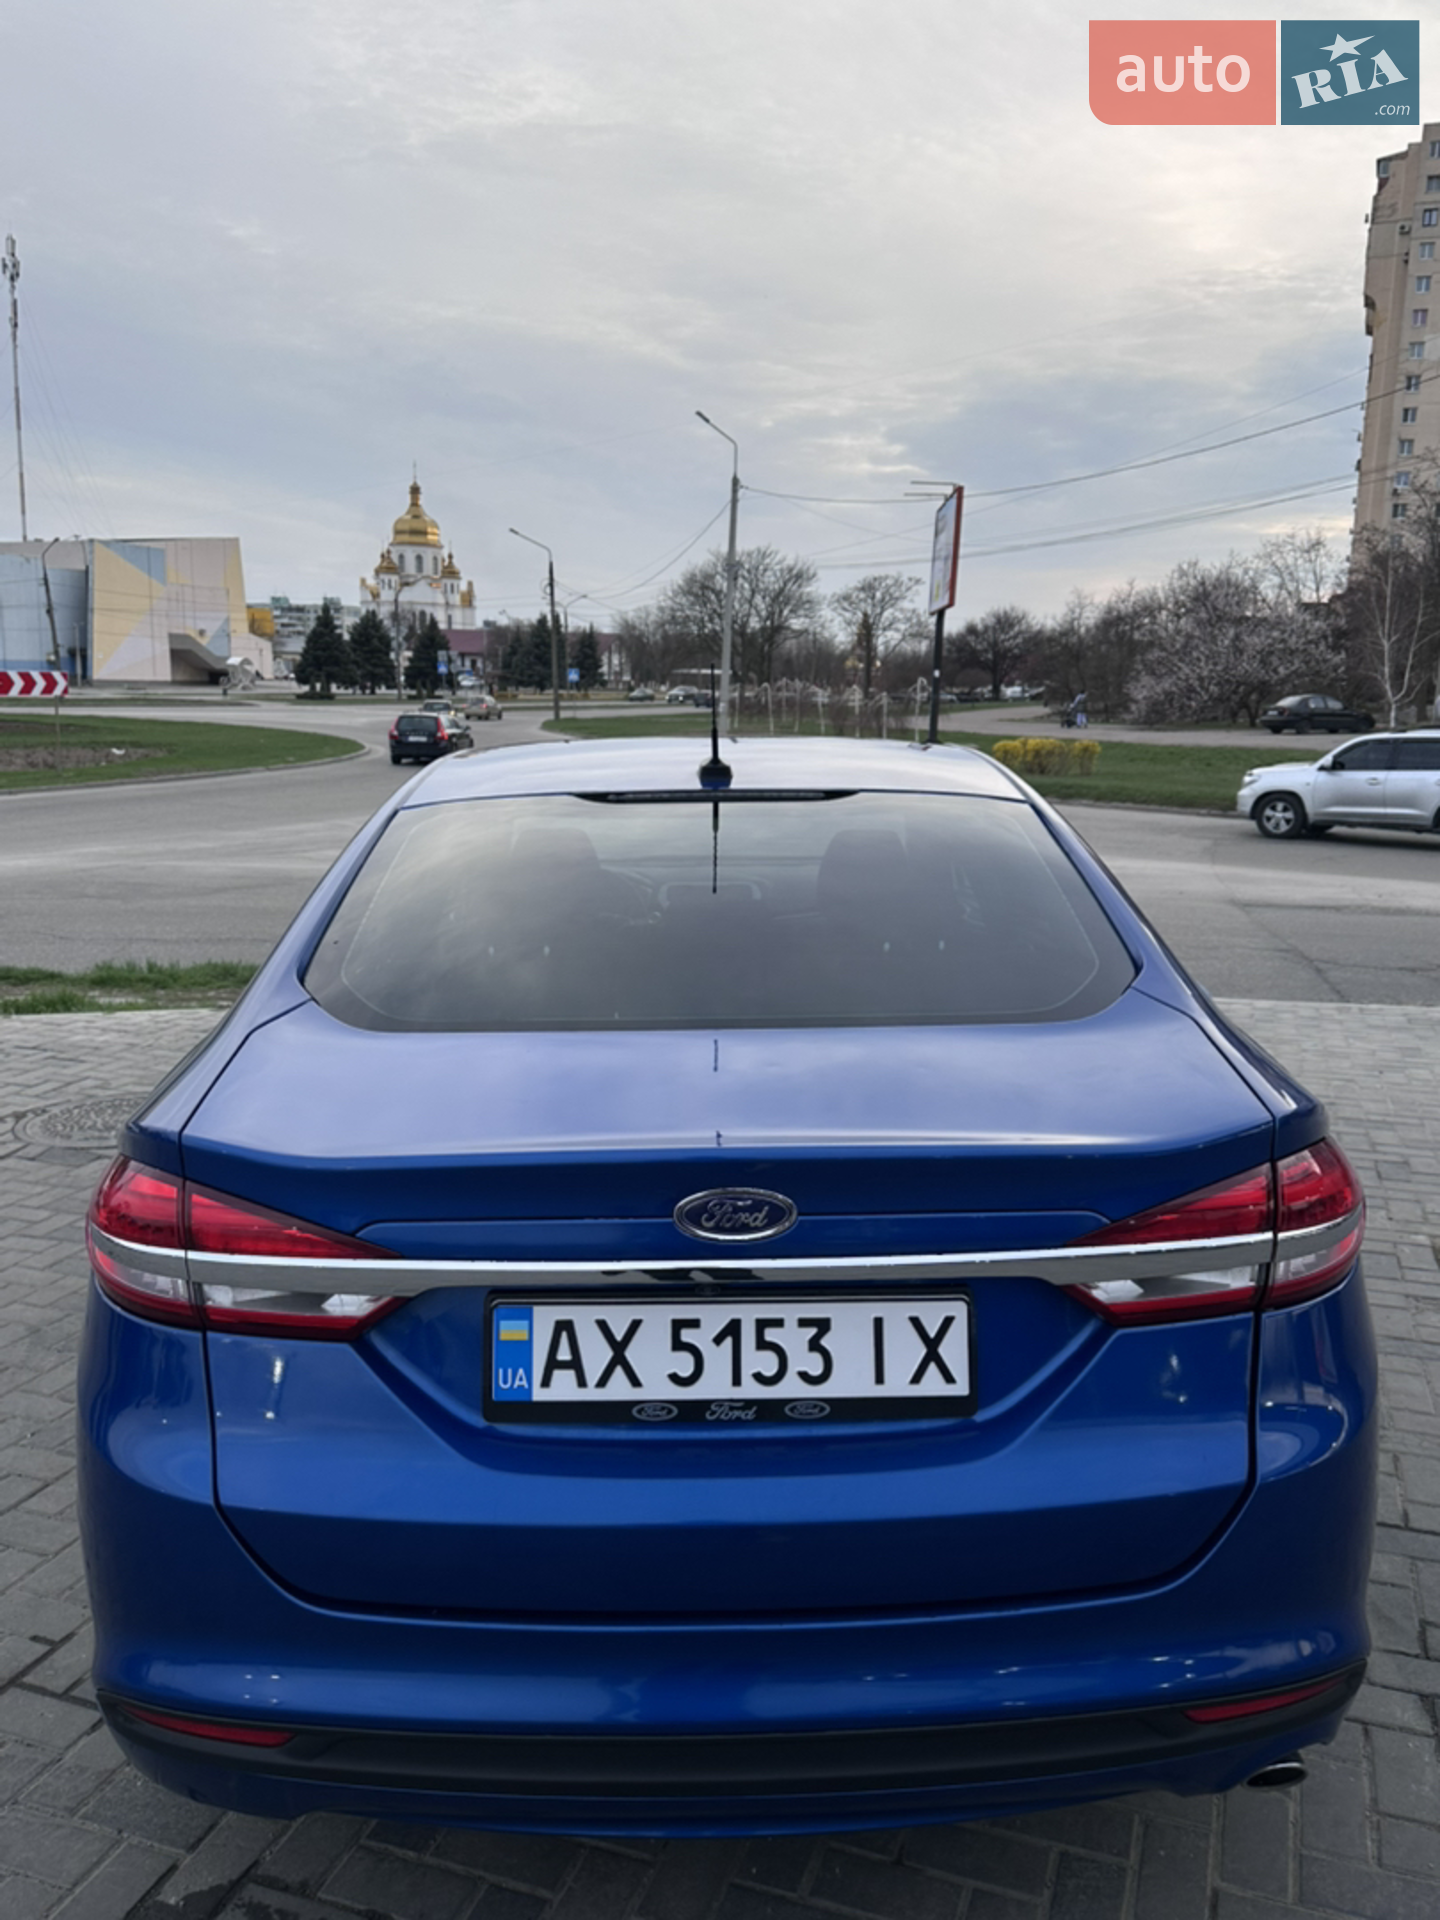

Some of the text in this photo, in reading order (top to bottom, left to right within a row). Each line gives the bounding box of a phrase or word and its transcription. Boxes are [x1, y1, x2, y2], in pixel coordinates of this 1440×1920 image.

[701, 1199, 769, 1228] Ford
[539, 1315, 958, 1389] AX 5153 IX
[498, 1367, 530, 1390] UA
[640, 1401, 821, 1421] Ford Ford Ford
